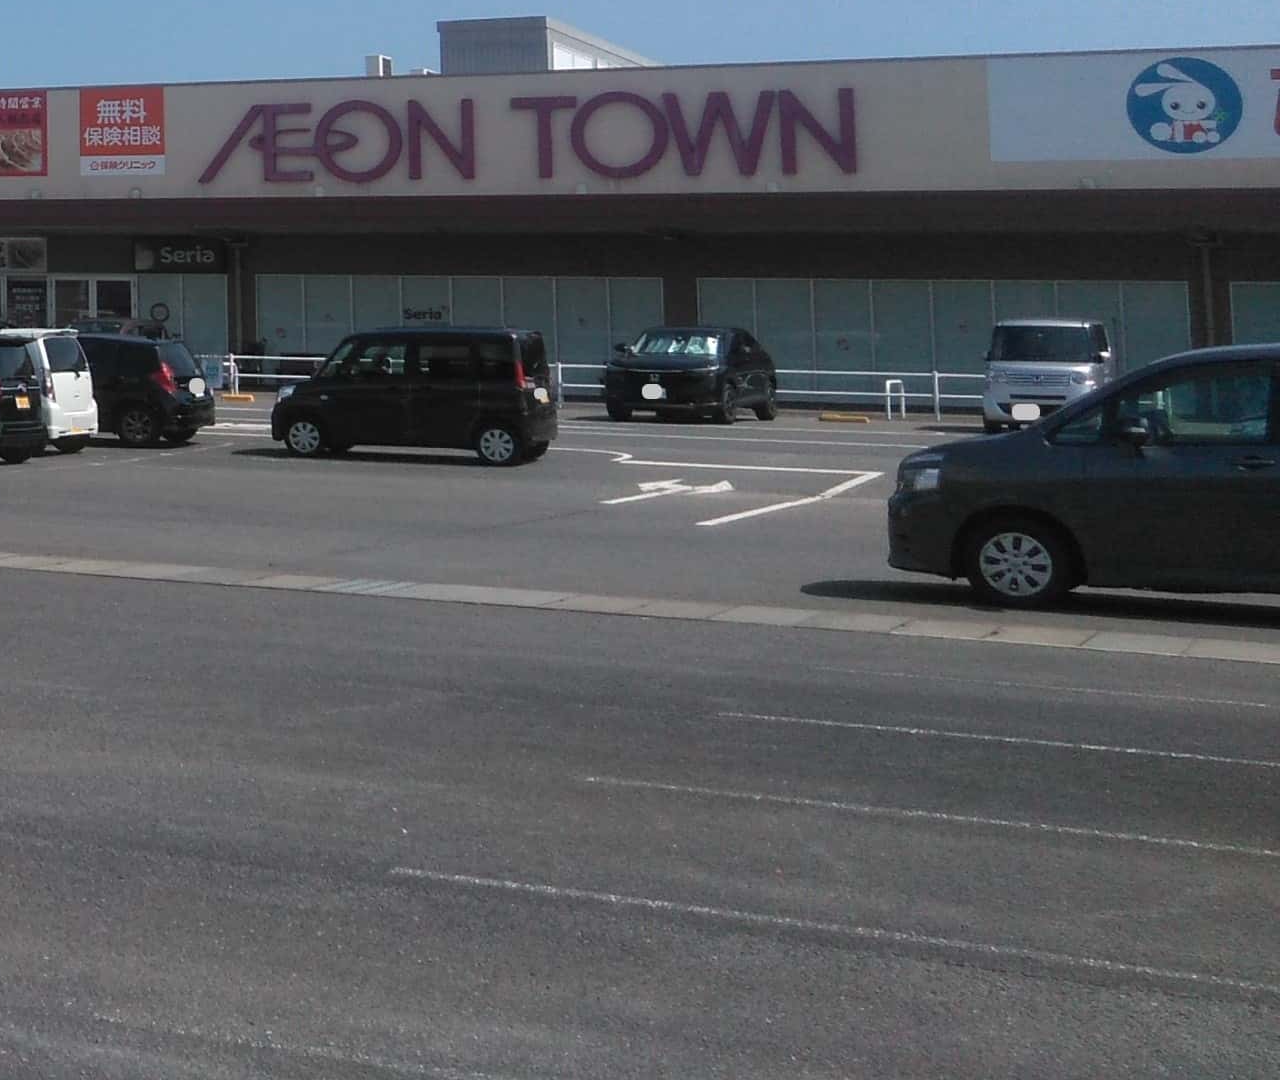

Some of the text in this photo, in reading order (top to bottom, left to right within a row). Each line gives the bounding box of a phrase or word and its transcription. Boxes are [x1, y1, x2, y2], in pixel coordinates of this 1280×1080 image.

[96, 98, 146, 125] 無料
[83, 125, 161, 147] 保険相談
[509, 87, 858, 180] TOWN
[160, 245, 216, 263] Seria
